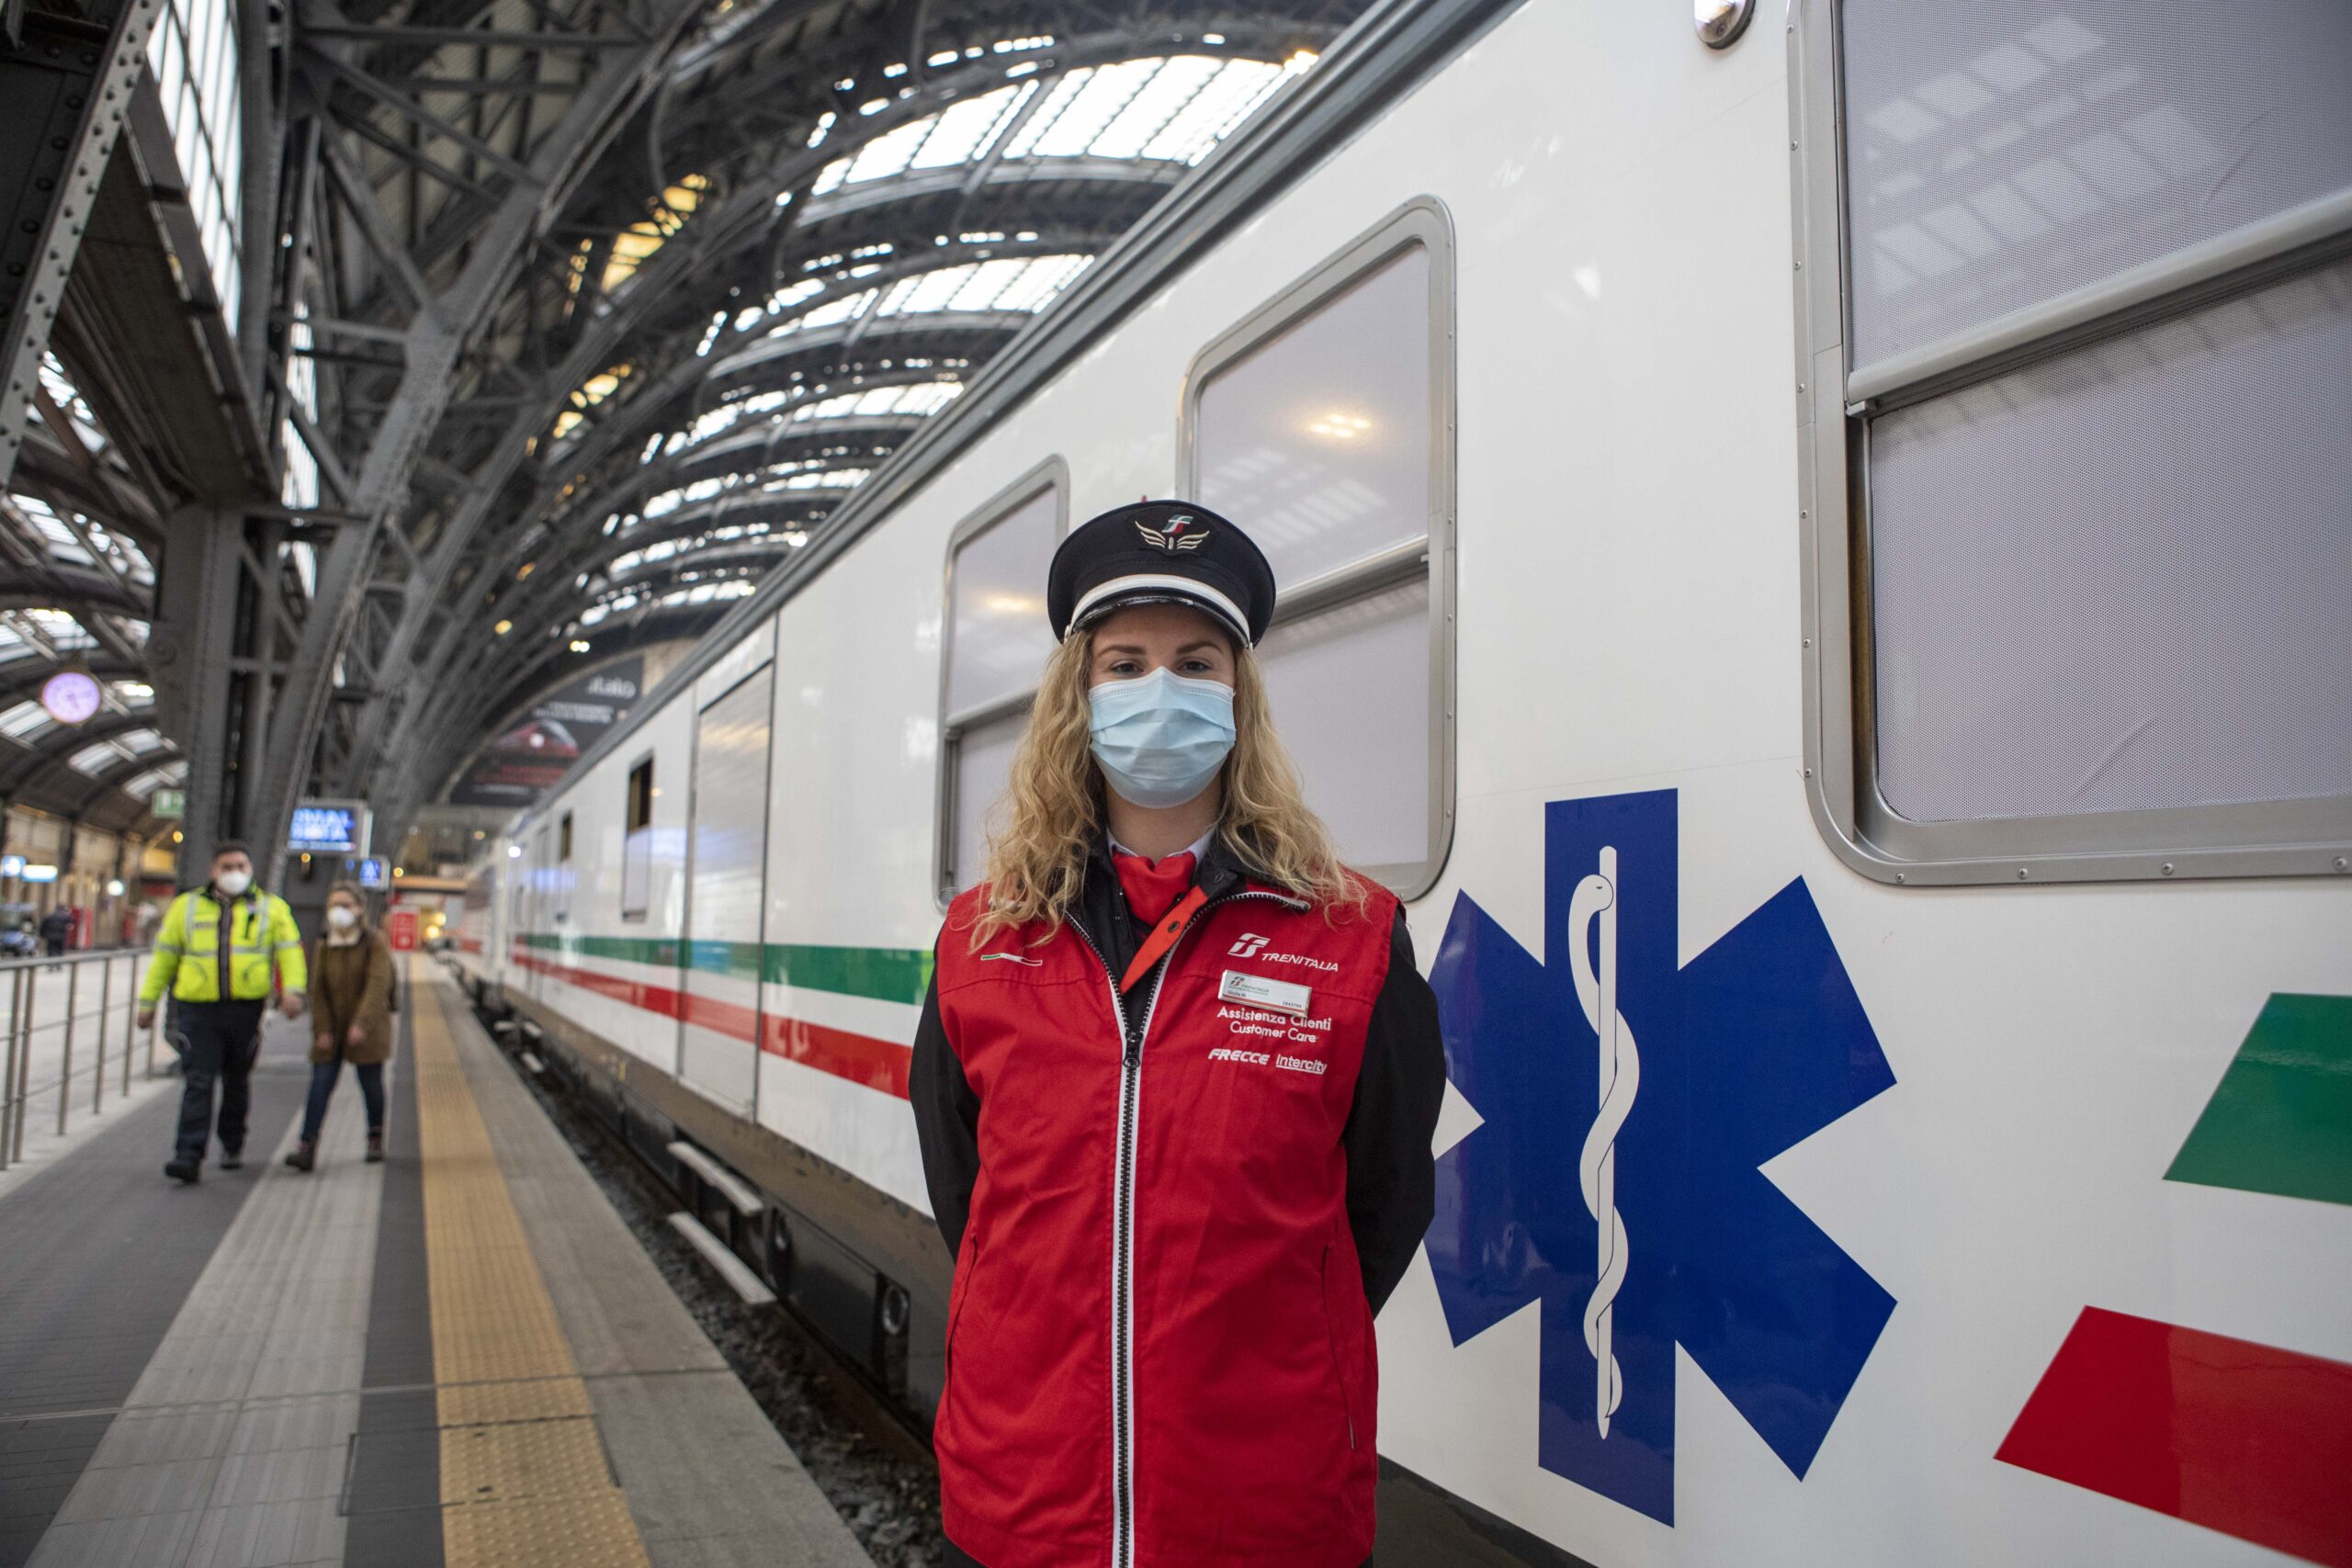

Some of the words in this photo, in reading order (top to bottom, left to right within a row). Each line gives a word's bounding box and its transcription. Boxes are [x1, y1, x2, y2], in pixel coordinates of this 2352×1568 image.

[1261, 953, 1339, 972] TRENITALIA
[1216, 1006, 1286, 1025] Assistenza
[1290, 1015, 1332, 1031] Clienti
[1229, 1021, 1285, 1038] Customer
[1287, 1028, 1317, 1043] Care
[1208, 1048, 1271, 1066] FRECCE
[1275, 1054, 1328, 1074] Intercity
